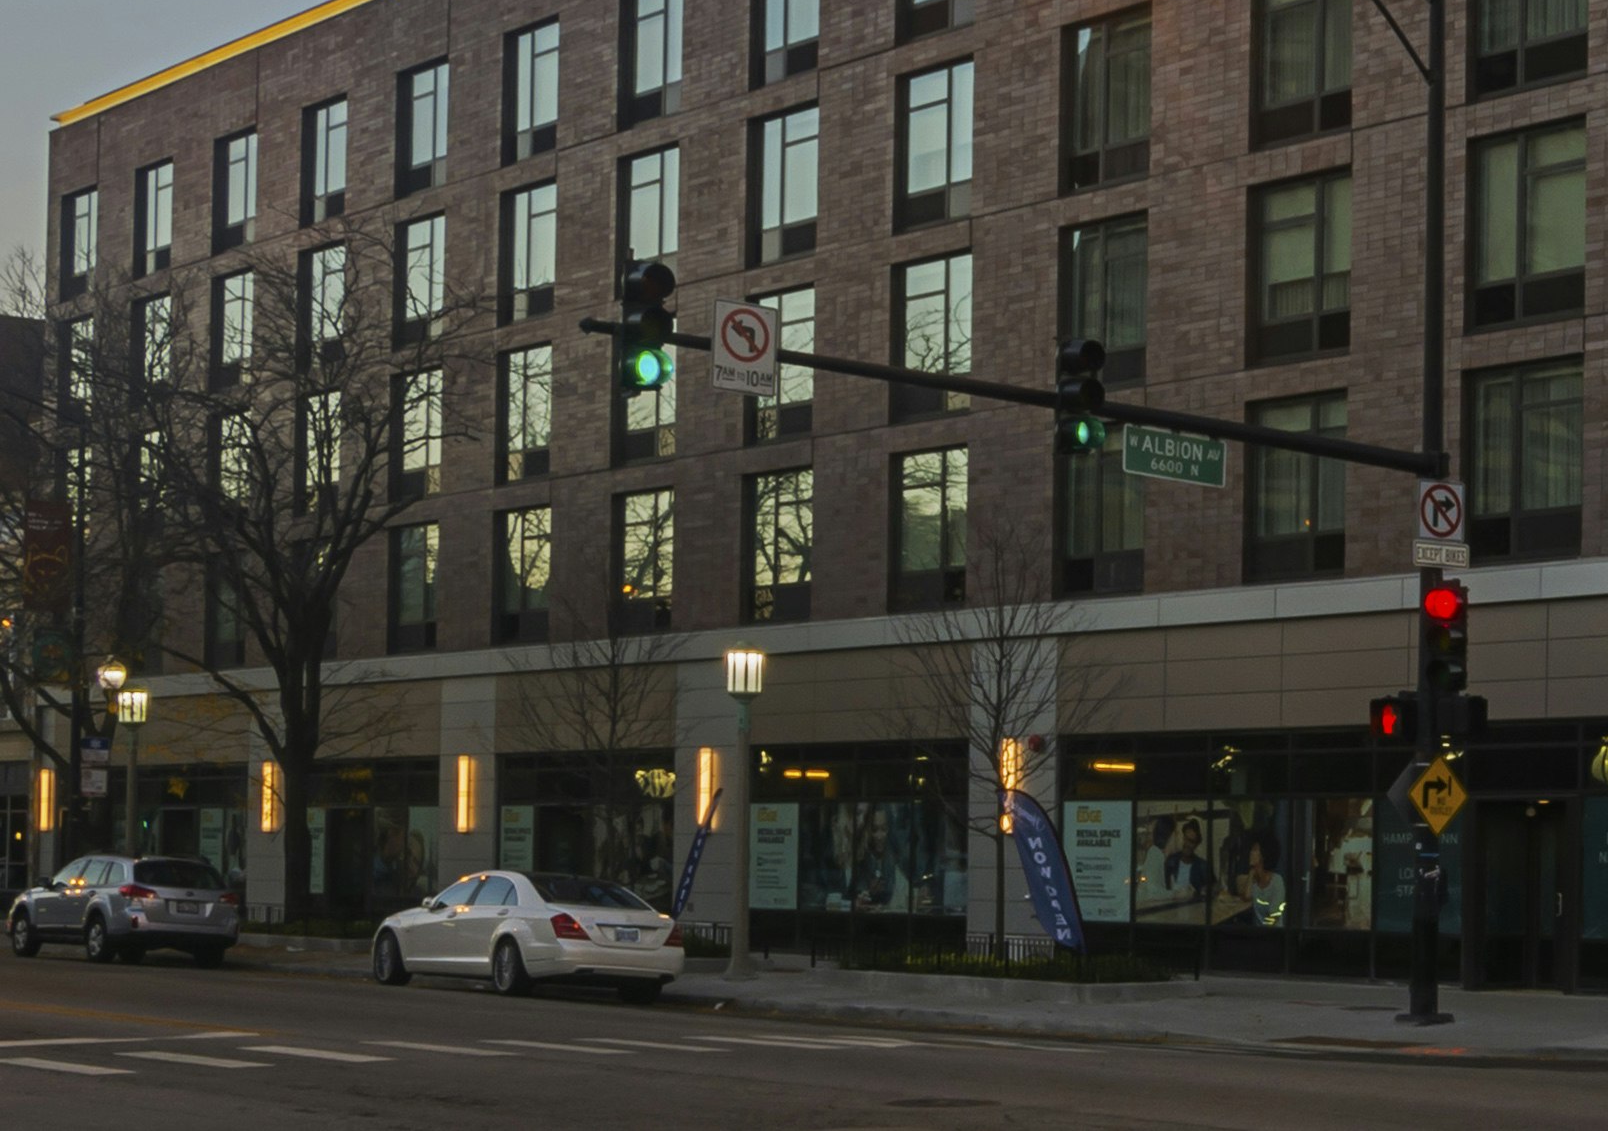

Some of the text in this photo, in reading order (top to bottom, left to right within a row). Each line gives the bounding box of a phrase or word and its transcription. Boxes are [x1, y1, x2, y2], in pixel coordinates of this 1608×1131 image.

[1129, 434, 1221, 461] W ALBION AV
[1150, 458, 1199, 476] 6600 N
[1383, 833, 1459, 844] HAMP NN
